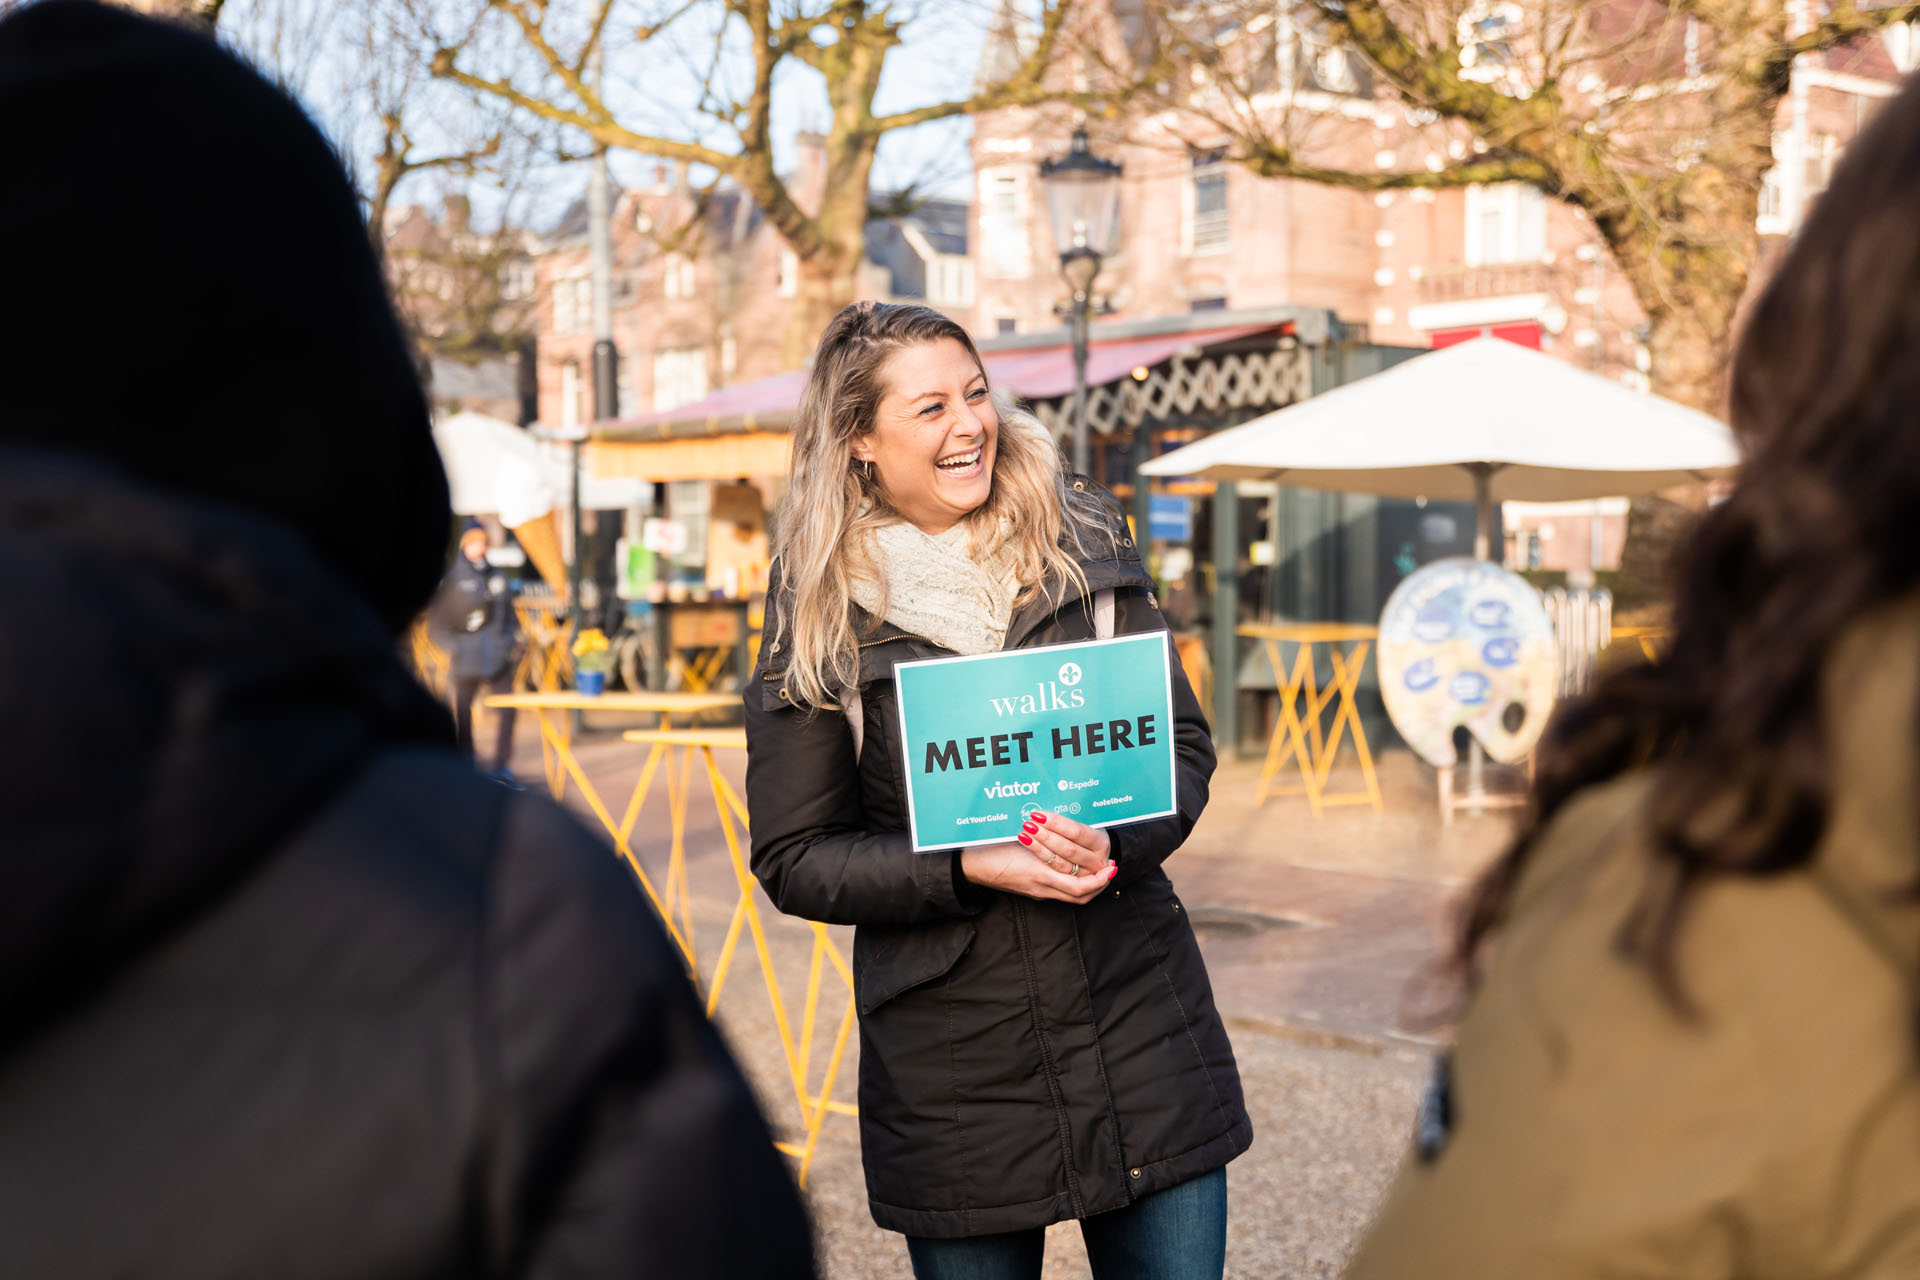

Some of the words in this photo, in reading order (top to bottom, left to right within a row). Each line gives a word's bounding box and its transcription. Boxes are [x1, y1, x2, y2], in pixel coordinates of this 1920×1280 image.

[989, 681, 1085, 717] walks
[924, 731, 1034, 774] MEET
[1051, 714, 1156, 759] HERE
[983, 781, 1041, 799] viator
[1068, 778, 1100, 791] Expedia
[1092, 794, 1134, 808] hotelbeds
[1053, 804, 1069, 815] gta
